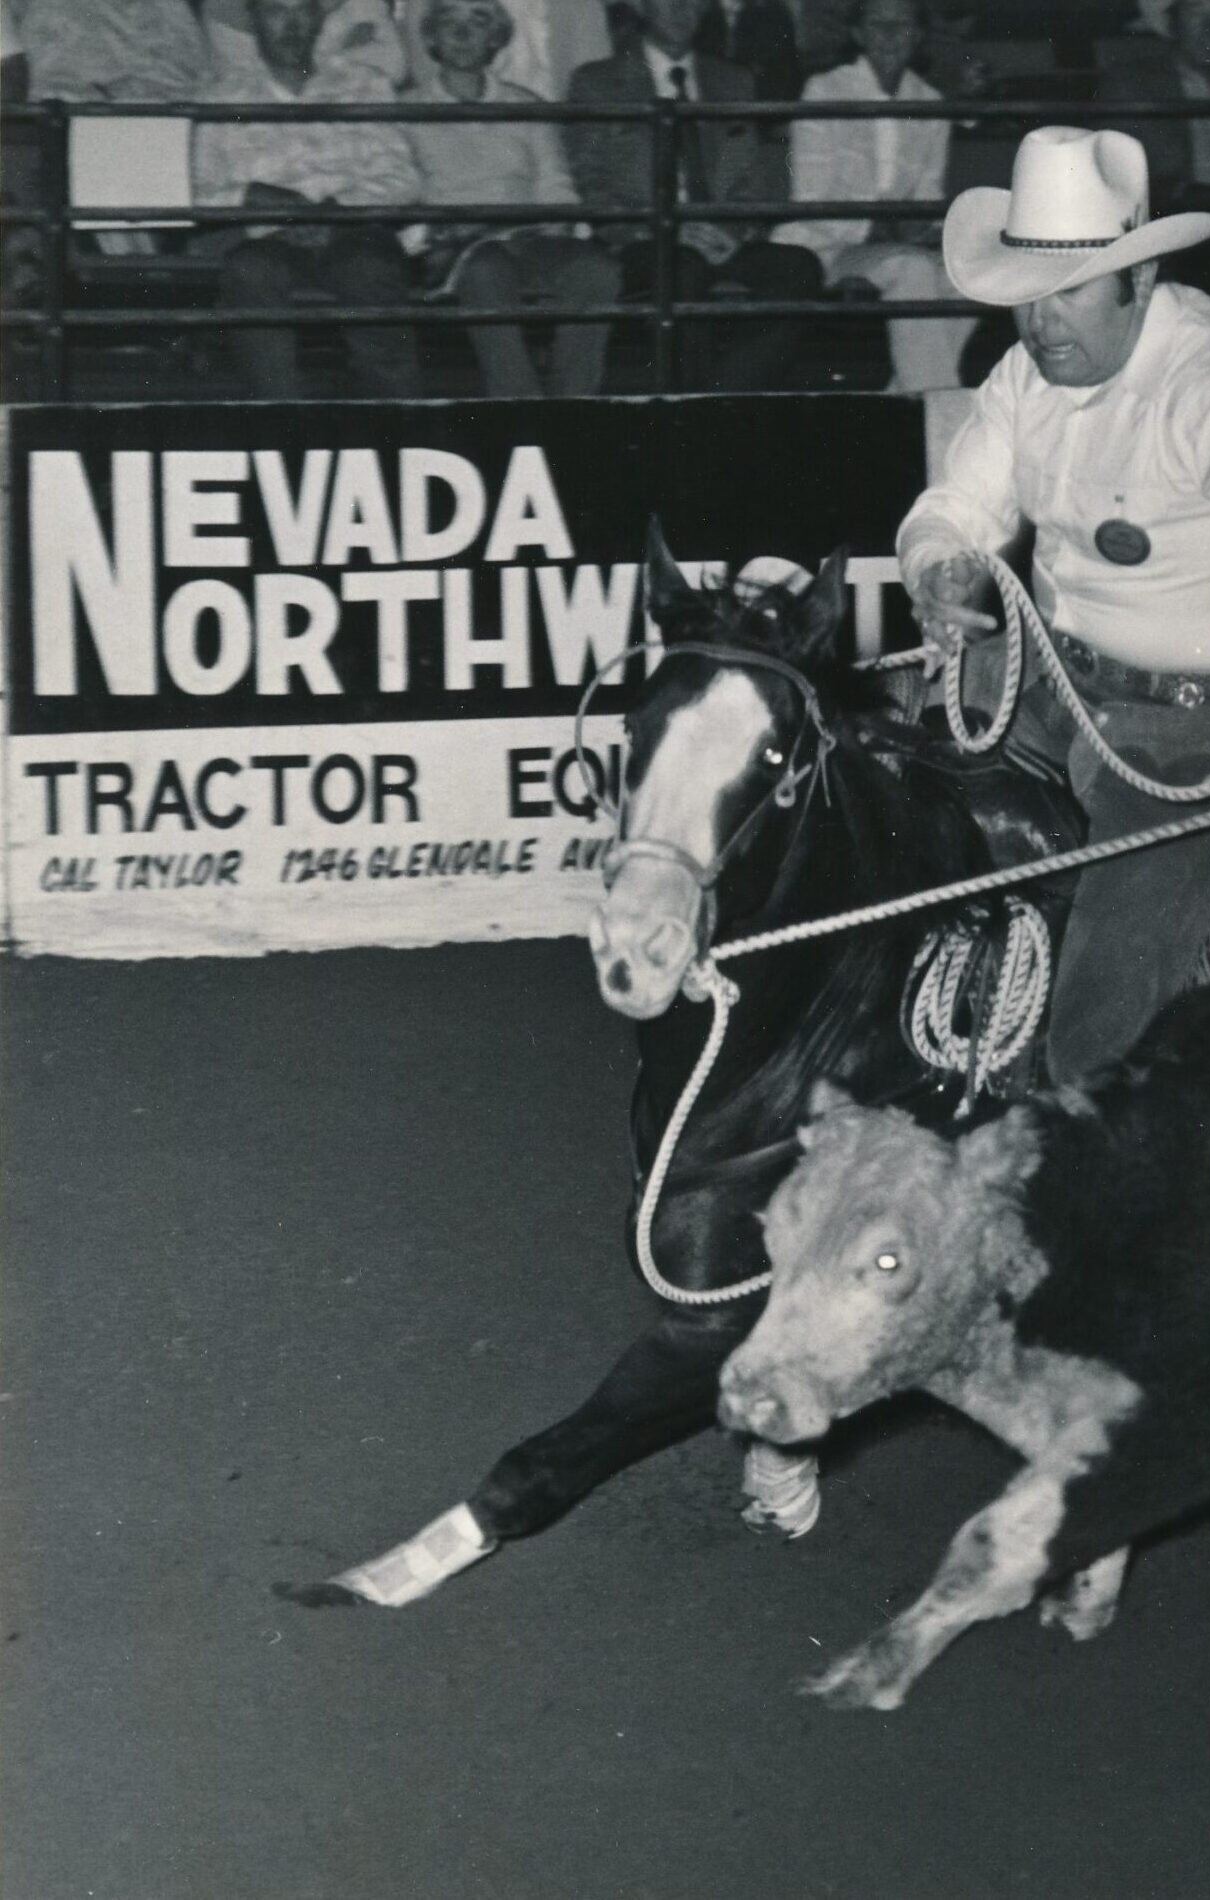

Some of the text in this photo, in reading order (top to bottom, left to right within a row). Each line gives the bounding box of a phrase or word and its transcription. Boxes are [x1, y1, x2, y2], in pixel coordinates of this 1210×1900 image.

[25, 754, 420, 835] TRACTOR
[39, 856, 99, 893] CAL
[114, 849, 244, 890] TAYLOR
[279, 846, 360, 883] 1246
[366, 837, 541, 880] GLENDALE
